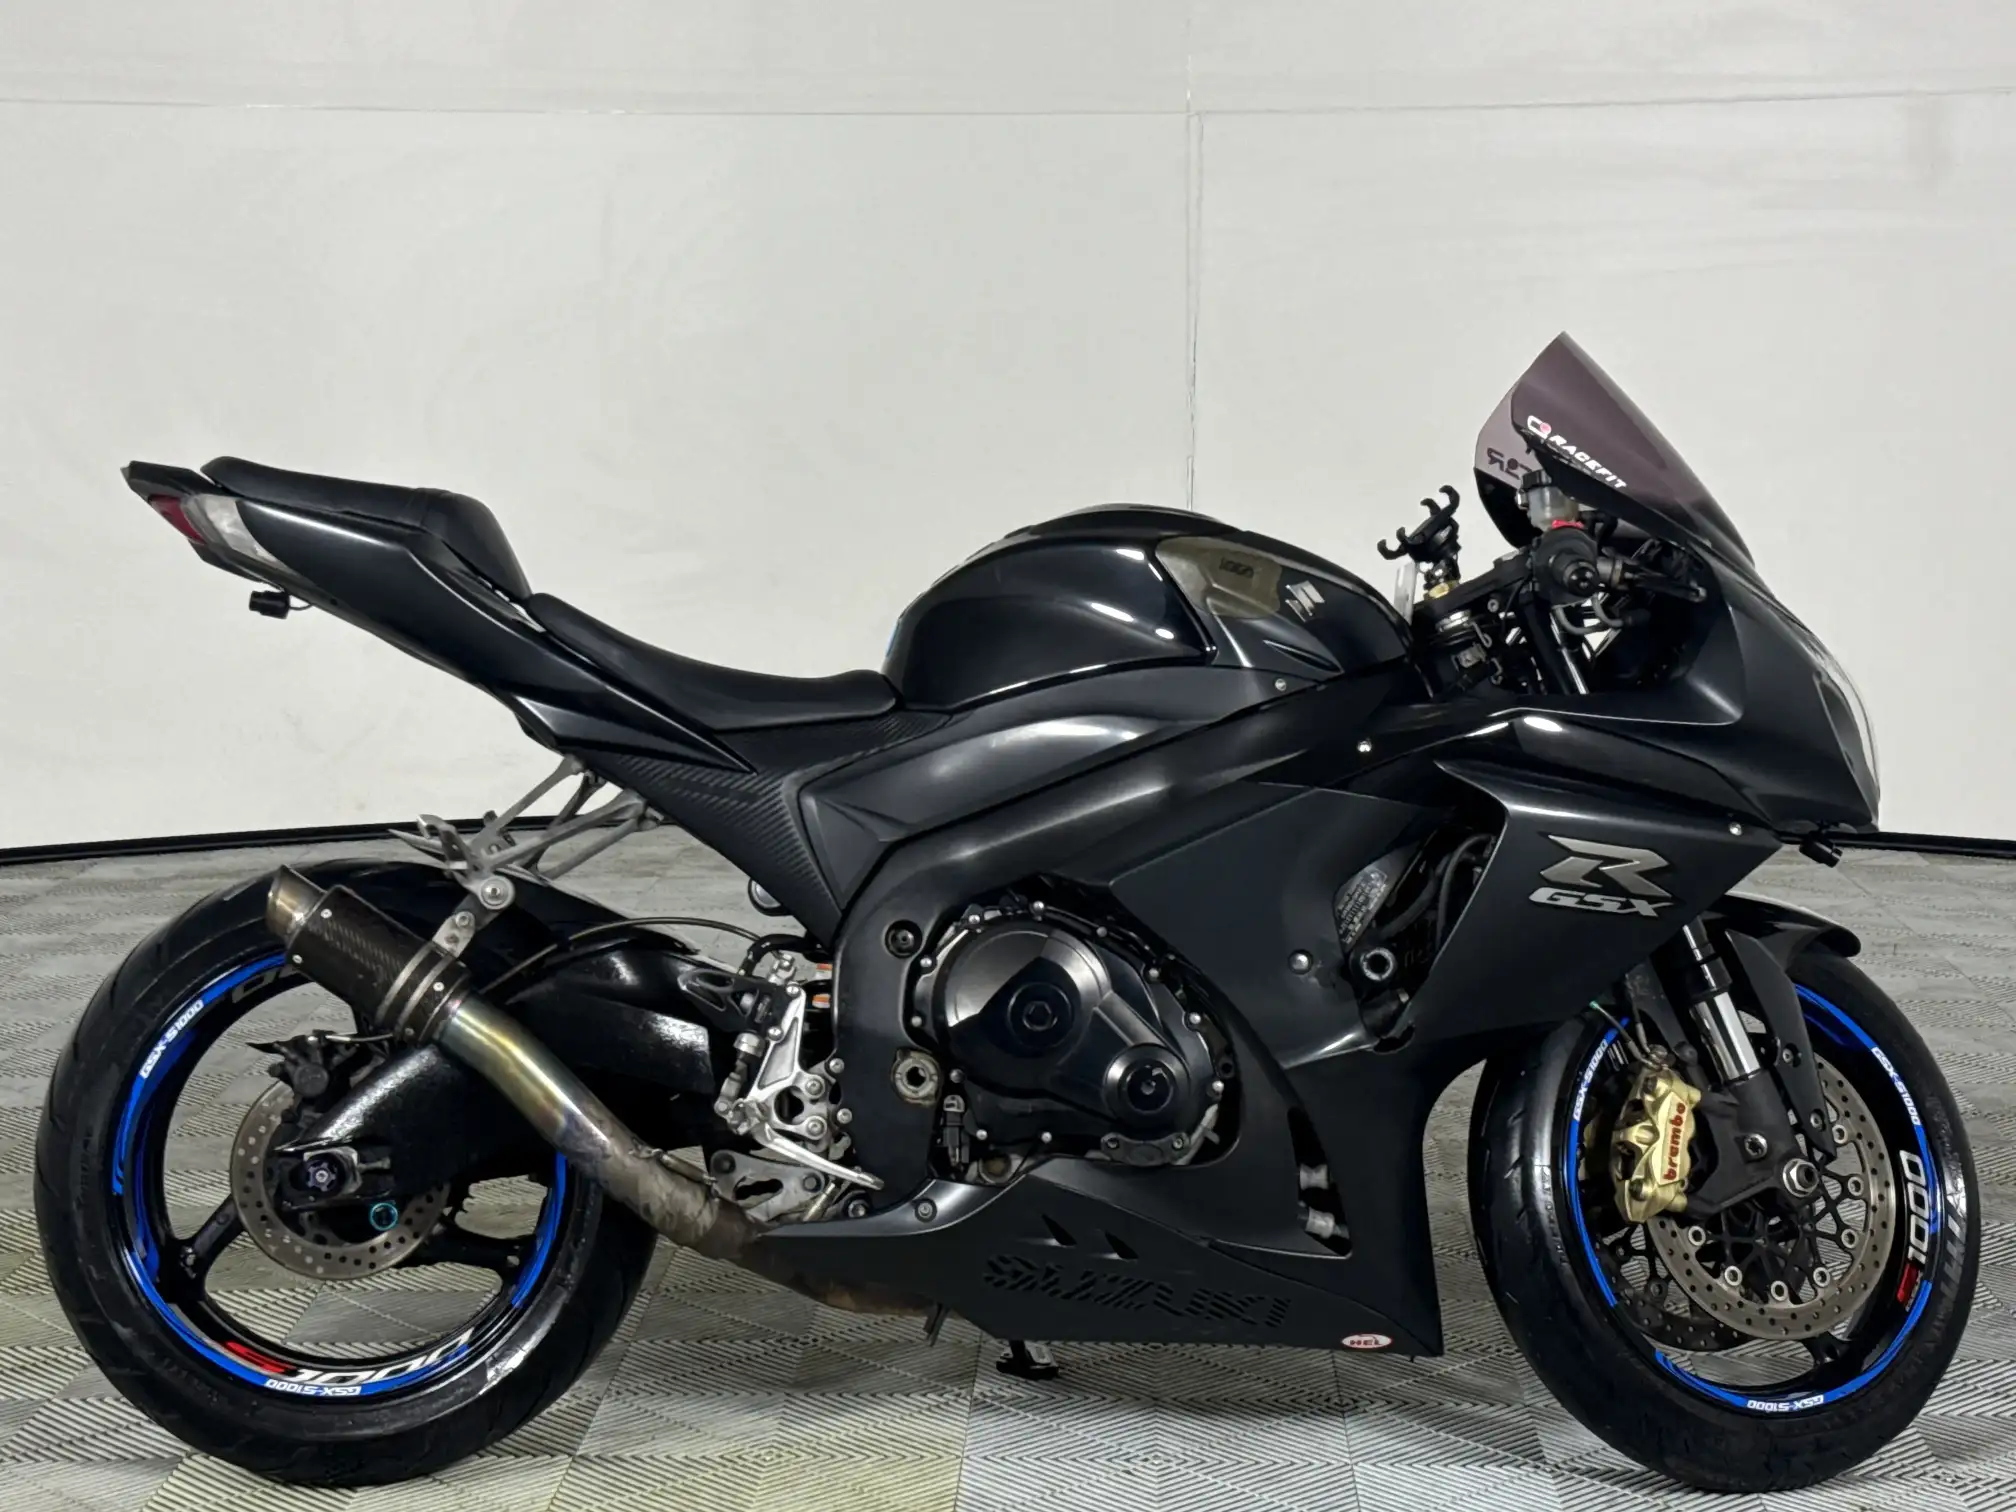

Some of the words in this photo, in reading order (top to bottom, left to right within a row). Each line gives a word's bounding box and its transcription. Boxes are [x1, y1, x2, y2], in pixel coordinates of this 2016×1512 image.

[1528, 887, 1674, 918] GSX
[139, 999, 205, 1079] GSX-S1000
[1572, 1038, 1609, 1122] GSX-S1000
[1870, 1046, 1923, 1126] GSX-S1000
[1663, 1102, 1687, 1181] brembo
[263, 1377, 362, 1396] GSX-S1000
[1746, 1394, 1825, 1413] GSX-S1000
